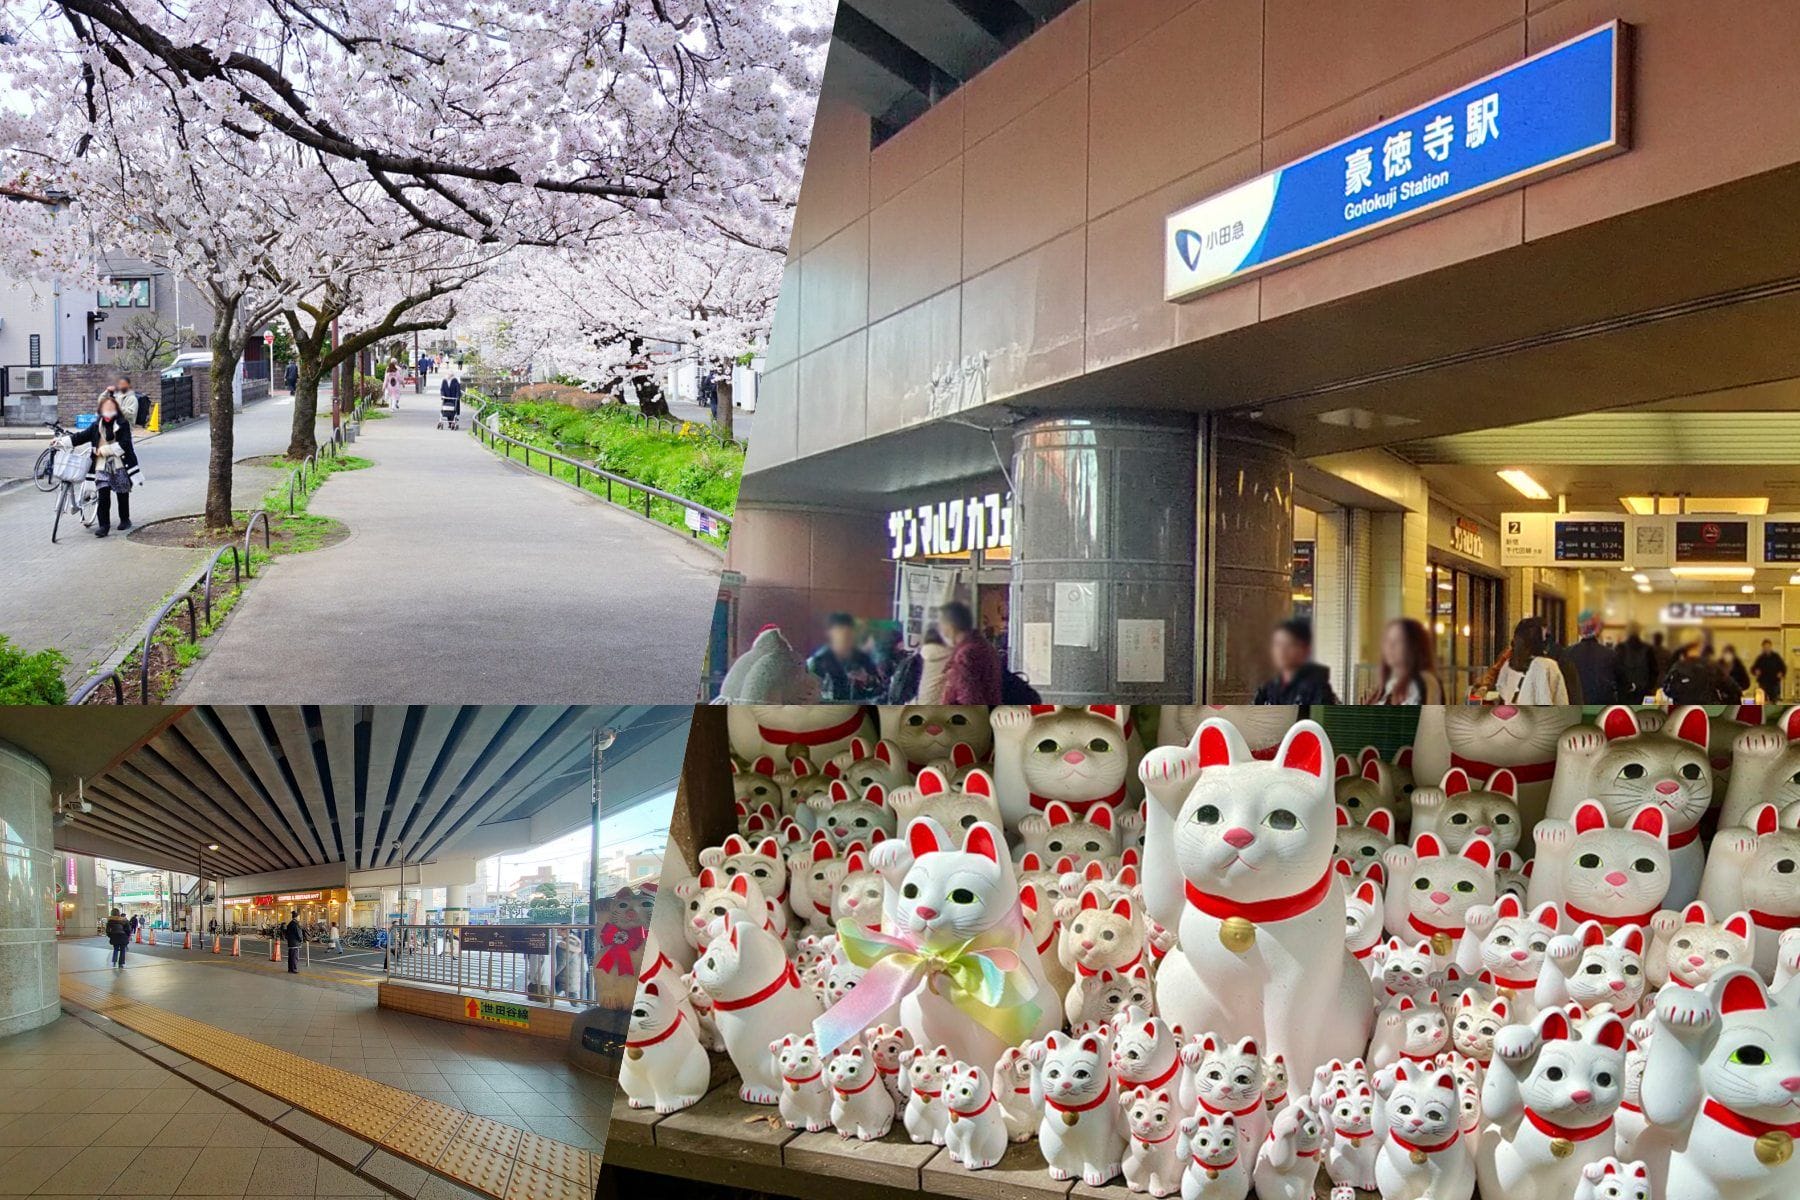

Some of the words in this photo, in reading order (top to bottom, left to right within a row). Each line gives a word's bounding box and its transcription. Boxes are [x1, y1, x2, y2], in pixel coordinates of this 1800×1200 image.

[1345, 92, 1499, 197] 豪徳寺駅
[1344, 186, 1397, 221] Gotokuji
[1400, 171, 1449, 201] Station
[1206, 220, 1244, 250] 小田急
[1510, 522, 1519, 533] 2
[484, 1003, 528, 1019] 世田谷線
